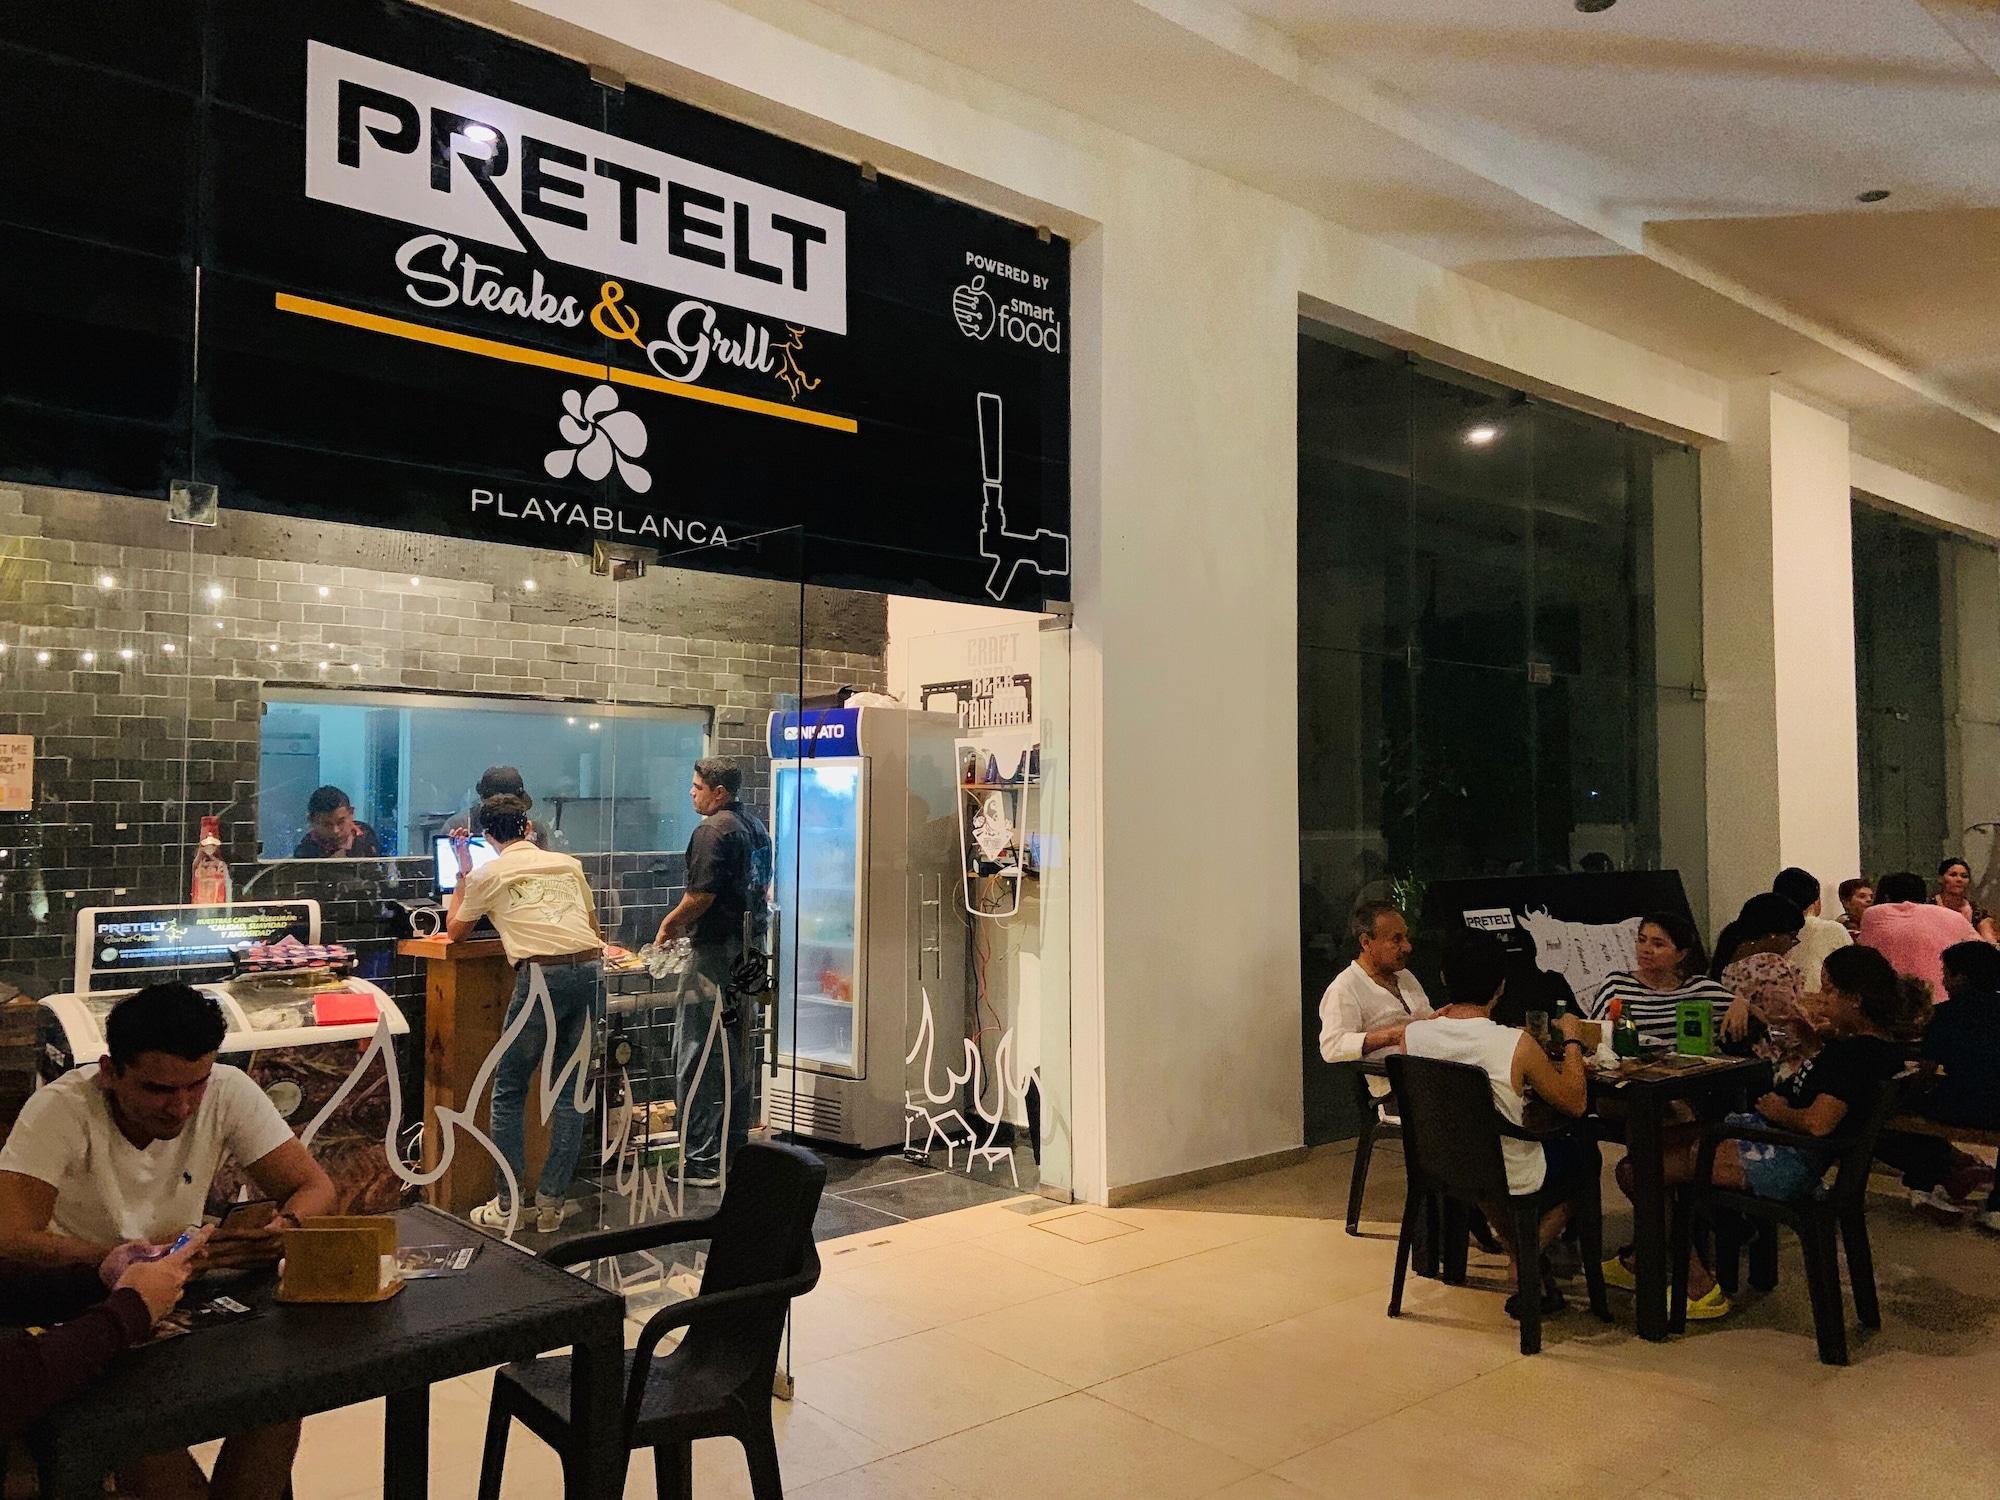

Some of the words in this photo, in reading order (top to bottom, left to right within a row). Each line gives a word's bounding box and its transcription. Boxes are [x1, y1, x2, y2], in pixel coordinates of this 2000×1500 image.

[338, 79, 827, 292] PRETELT
[965, 251, 1030, 284] POWERED
[1032, 273, 1050, 290] BY
[395, 234, 585, 327] Steaks
[590, 280, 648, 349] &
[646, 300, 775, 382] Grill
[998, 304, 1061, 354] food
[1010, 298, 1055, 323] smart
[471, 488, 731, 548] PLAYABLANCA
[98, 921, 167, 936] PRETELT
[1466, 914, 1511, 930] PRETELT
